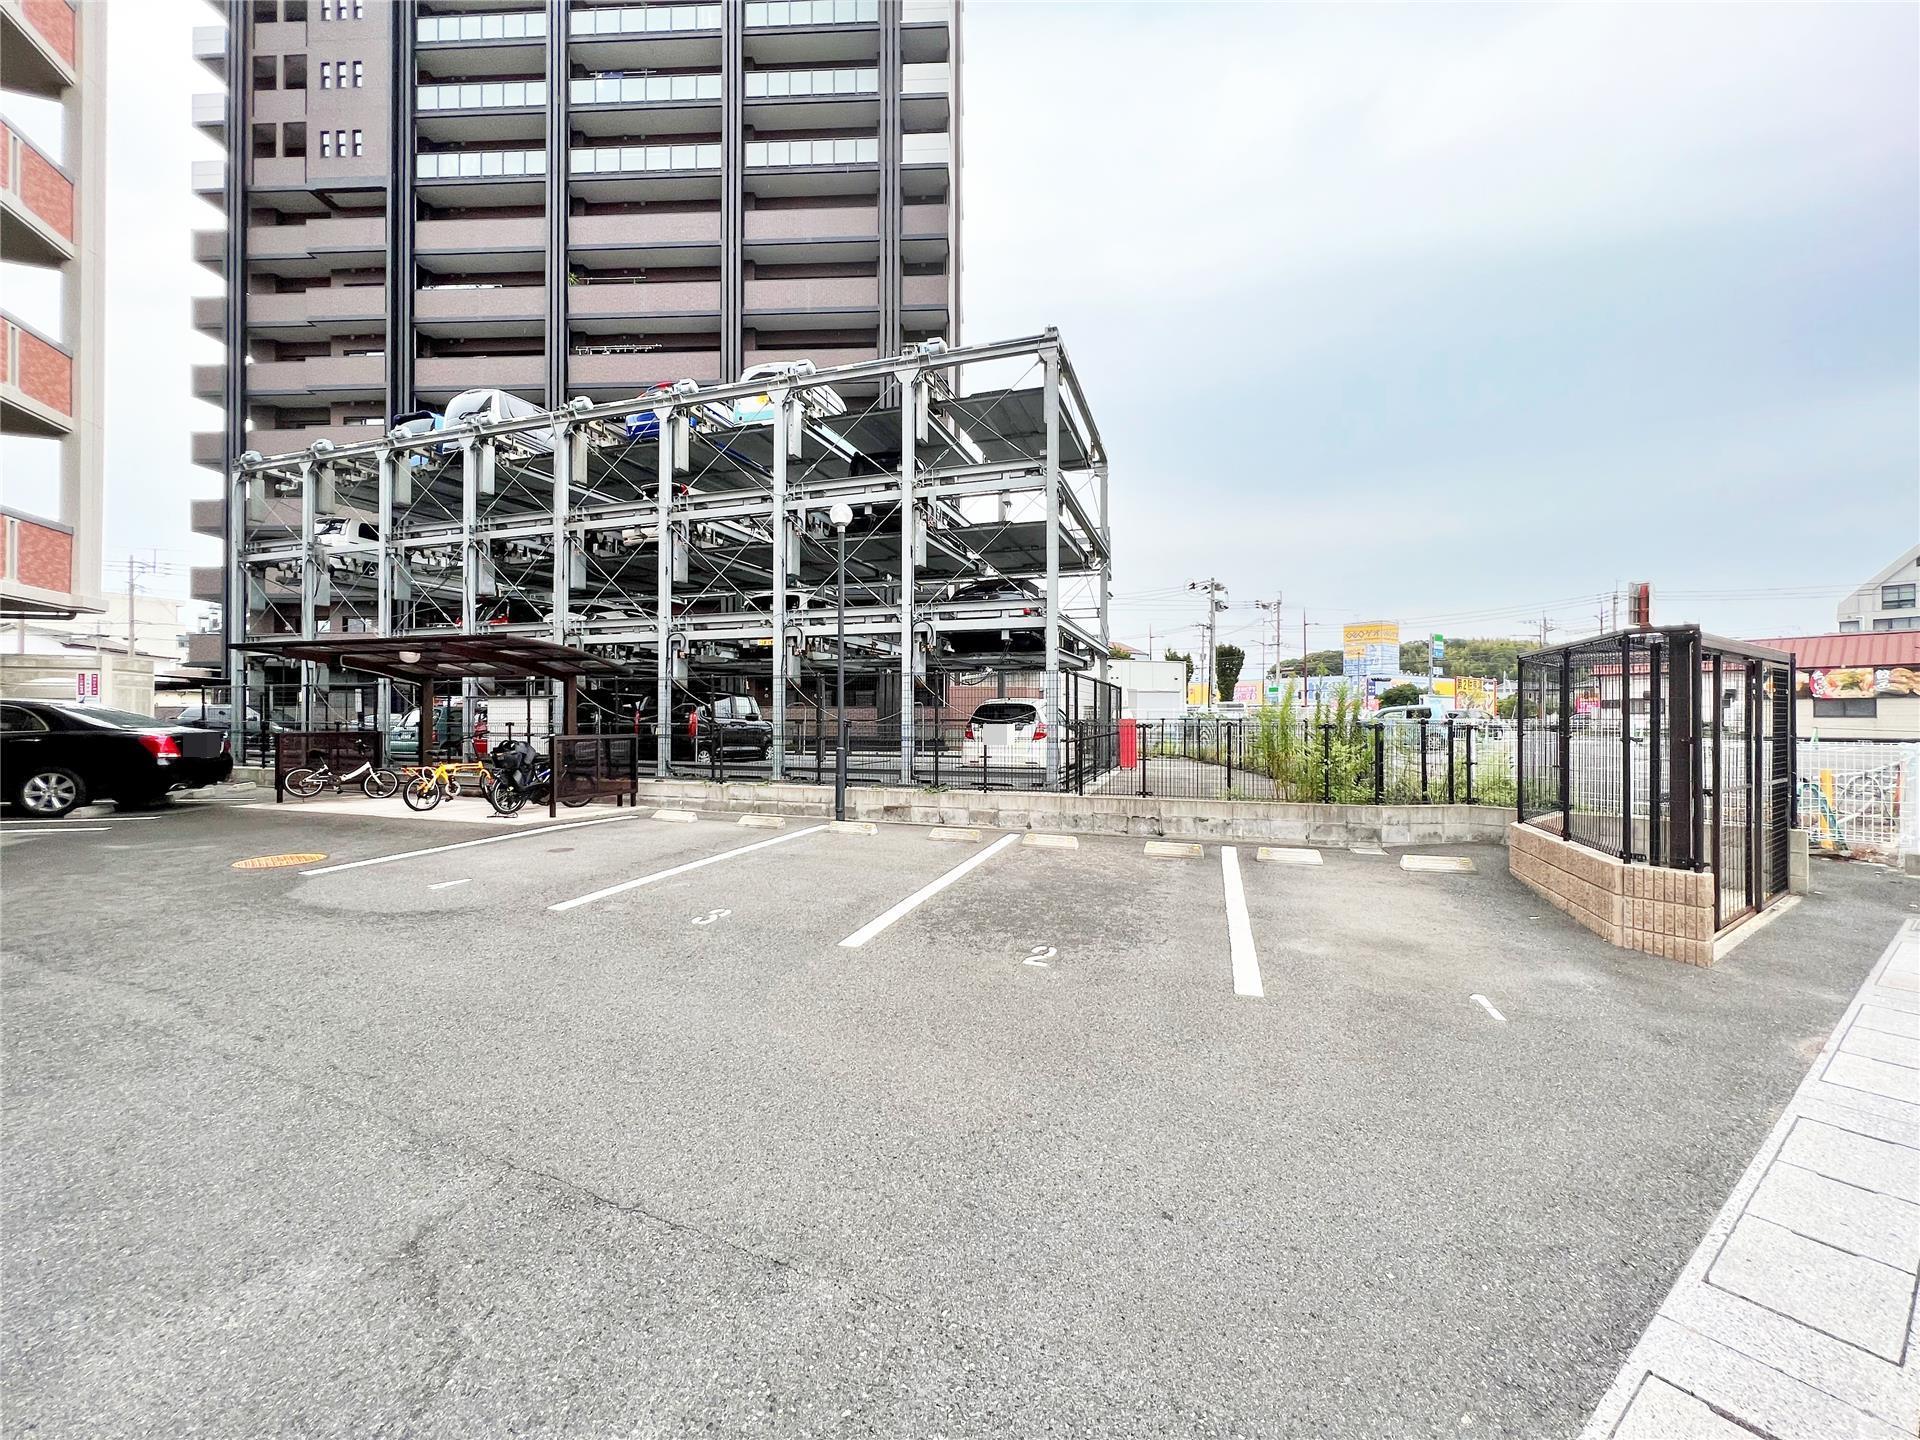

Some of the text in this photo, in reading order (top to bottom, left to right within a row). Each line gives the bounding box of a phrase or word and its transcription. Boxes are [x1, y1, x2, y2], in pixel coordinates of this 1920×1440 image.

[691, 908, 732, 925] 3
[1022, 945, 1058, 967] 2
[1469, 993, 1507, 1021] 1
